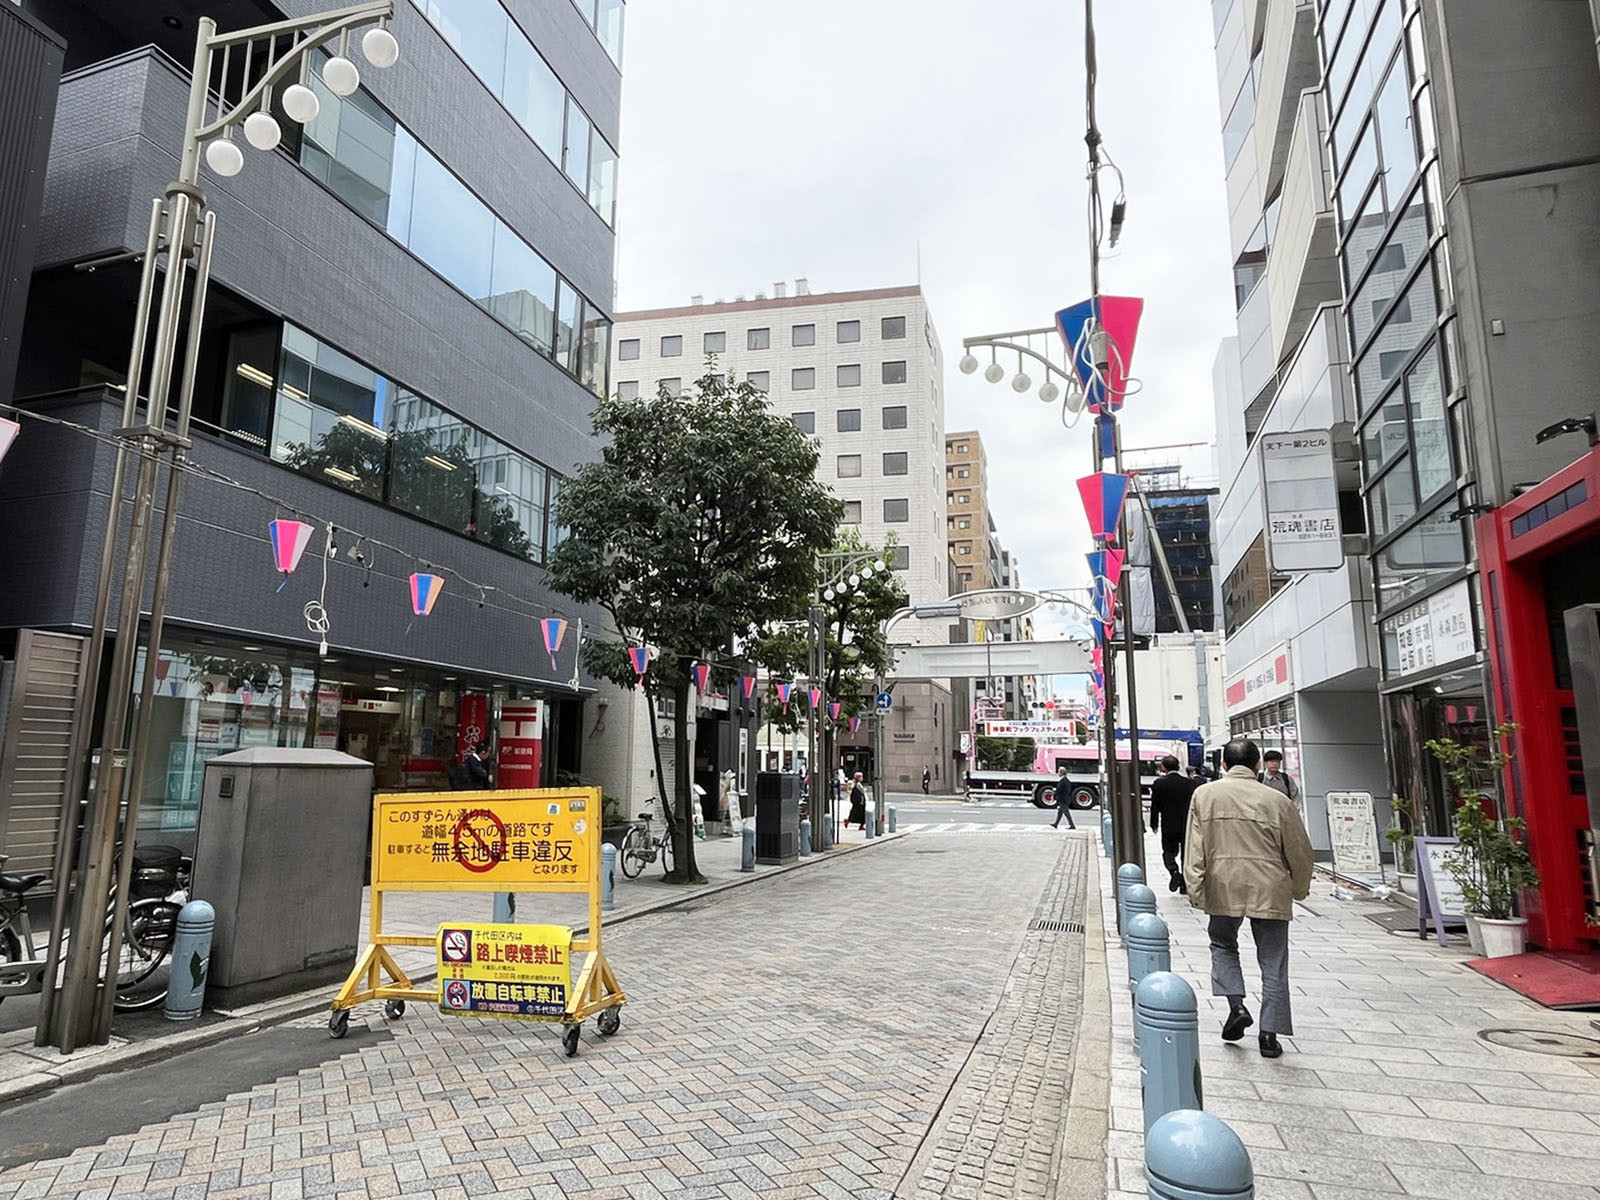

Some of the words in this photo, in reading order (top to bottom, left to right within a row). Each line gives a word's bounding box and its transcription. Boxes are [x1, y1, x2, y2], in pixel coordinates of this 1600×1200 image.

[1272, 518, 1335, 534] 荒魂書店
[388, 808, 491, 823] このすずらん通りは
[431, 840, 573, 863] 無余地駐車違反
[532, 864, 579, 875] となります
[474, 930, 523, 941] 千代田区内は
[476, 943, 564, 965] 路上喫煙禁止
[471, 983, 564, 1004] 放置自転車禁止
